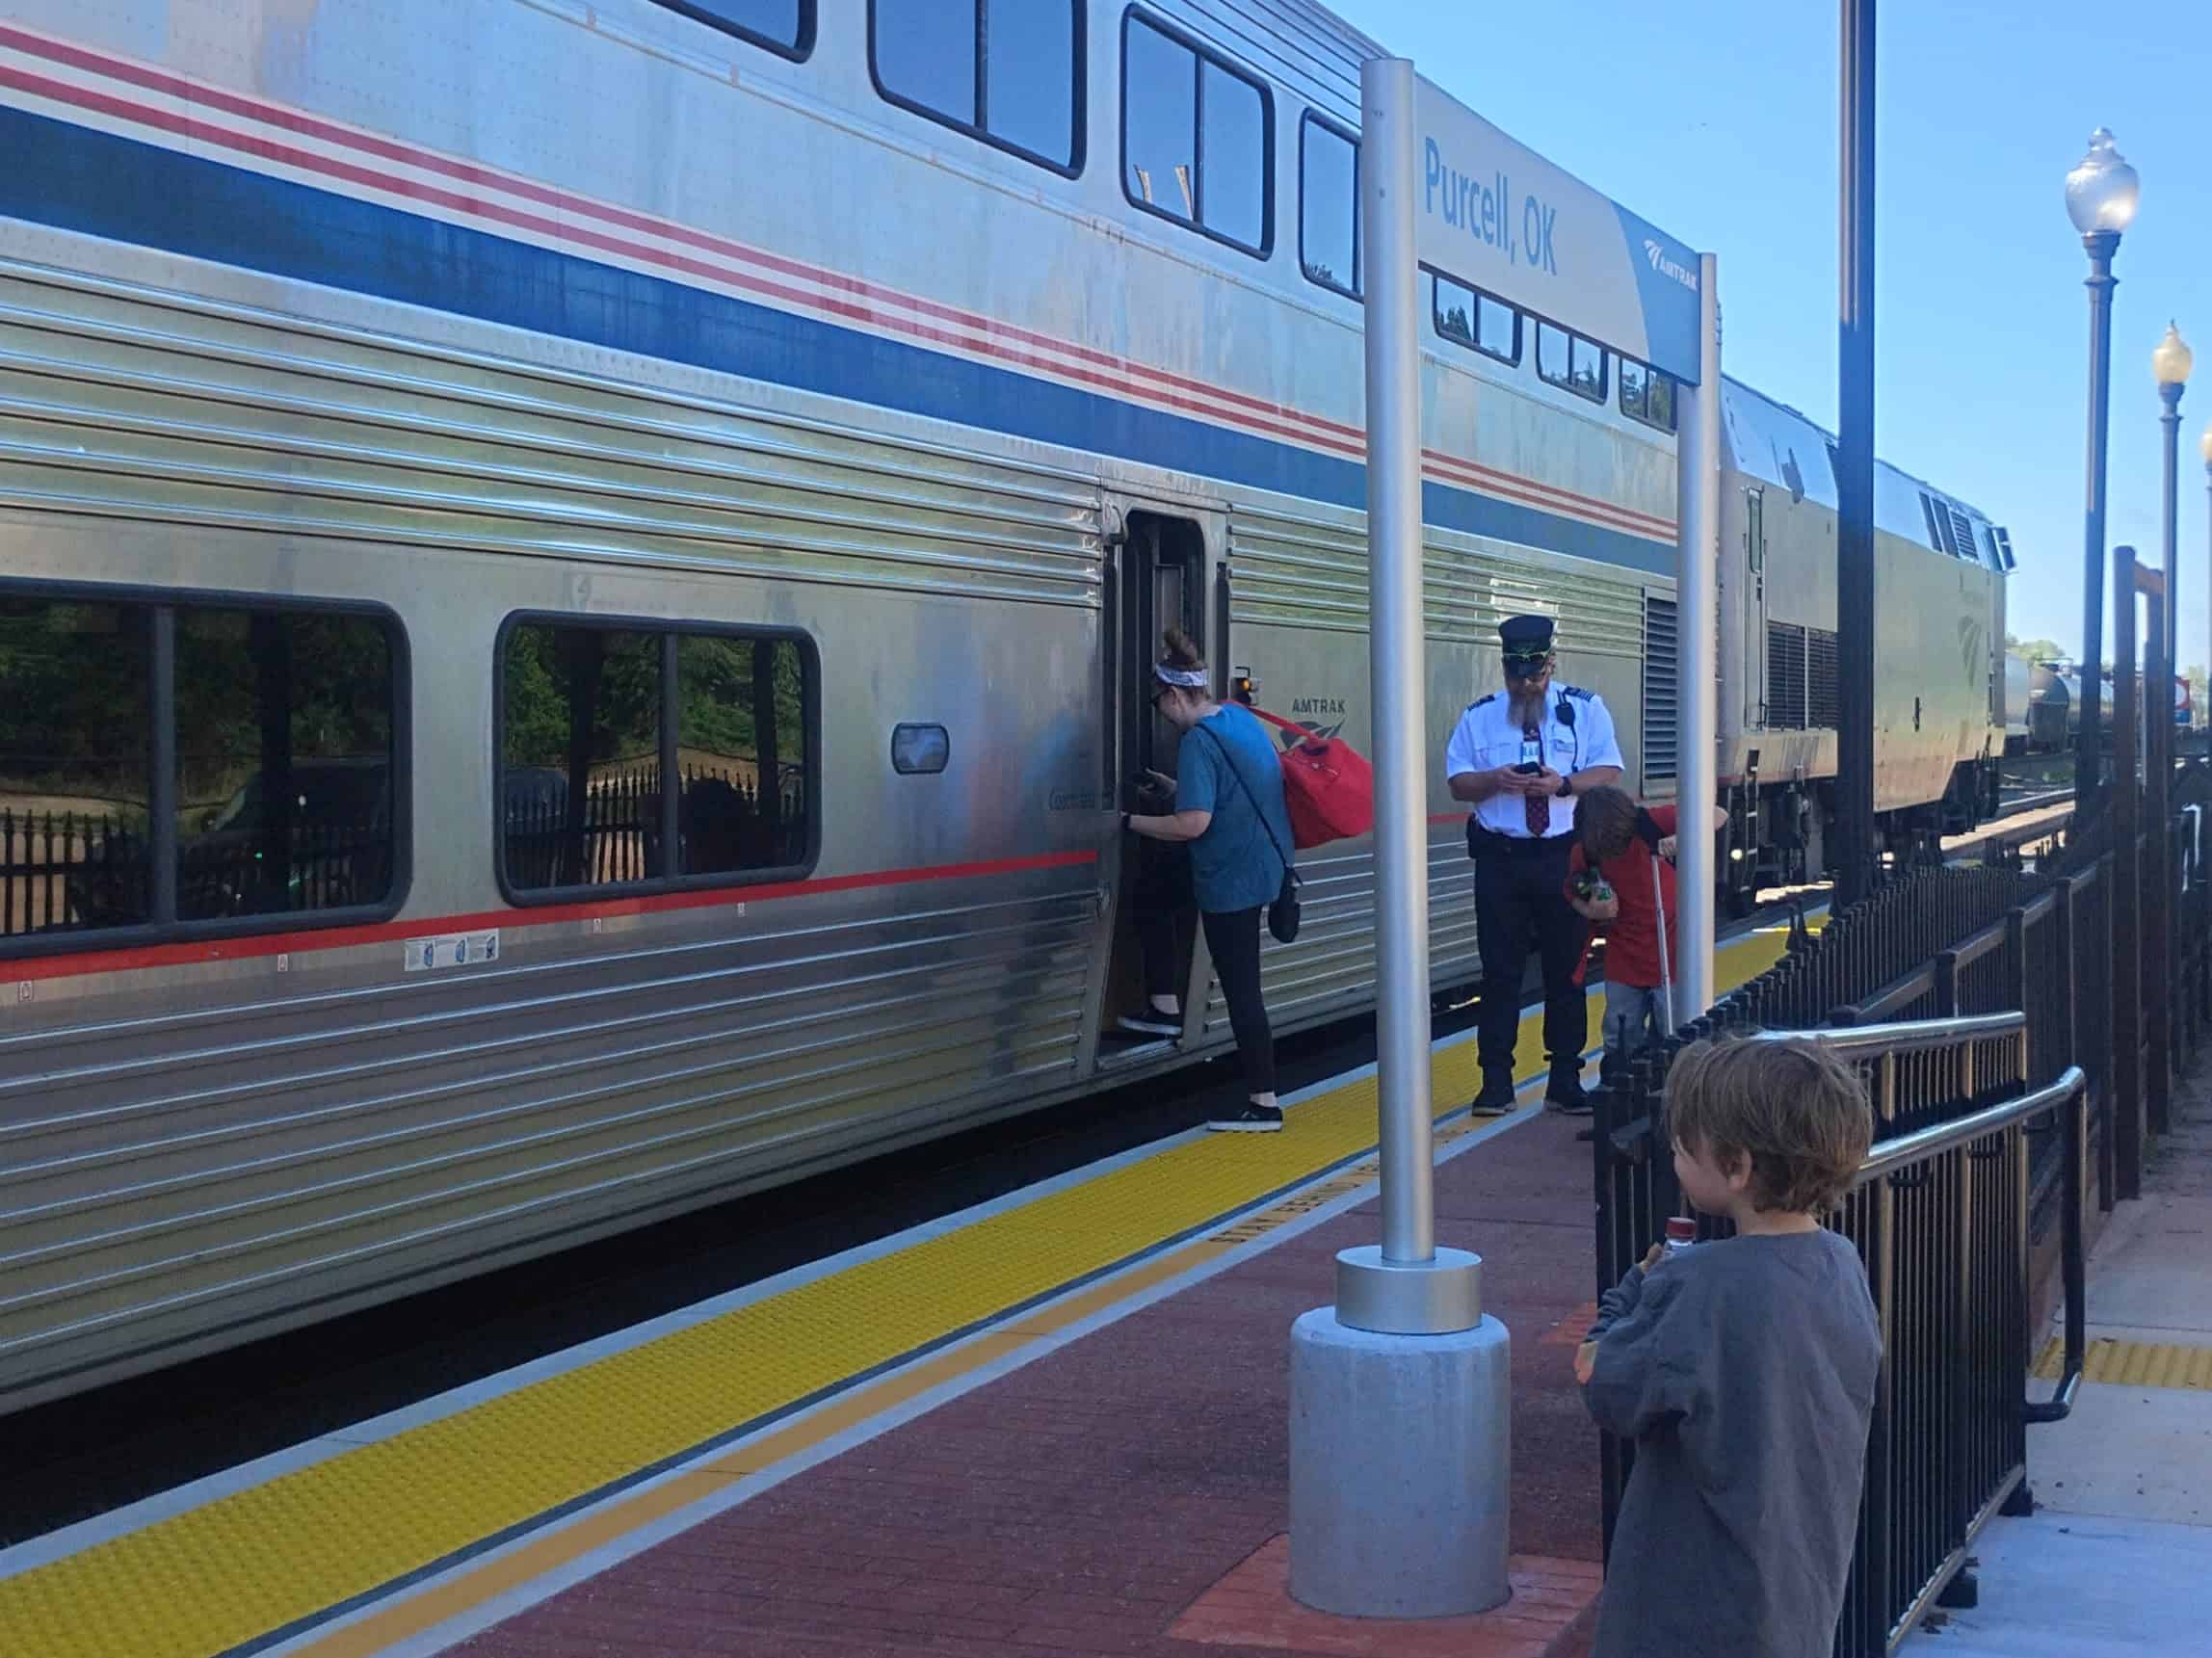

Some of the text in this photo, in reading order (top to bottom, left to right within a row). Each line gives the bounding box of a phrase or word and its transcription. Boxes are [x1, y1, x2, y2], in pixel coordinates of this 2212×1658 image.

[1425, 136, 1558, 276] Purcell, OK
[1292, 697, 1346, 714] AMTRAK
